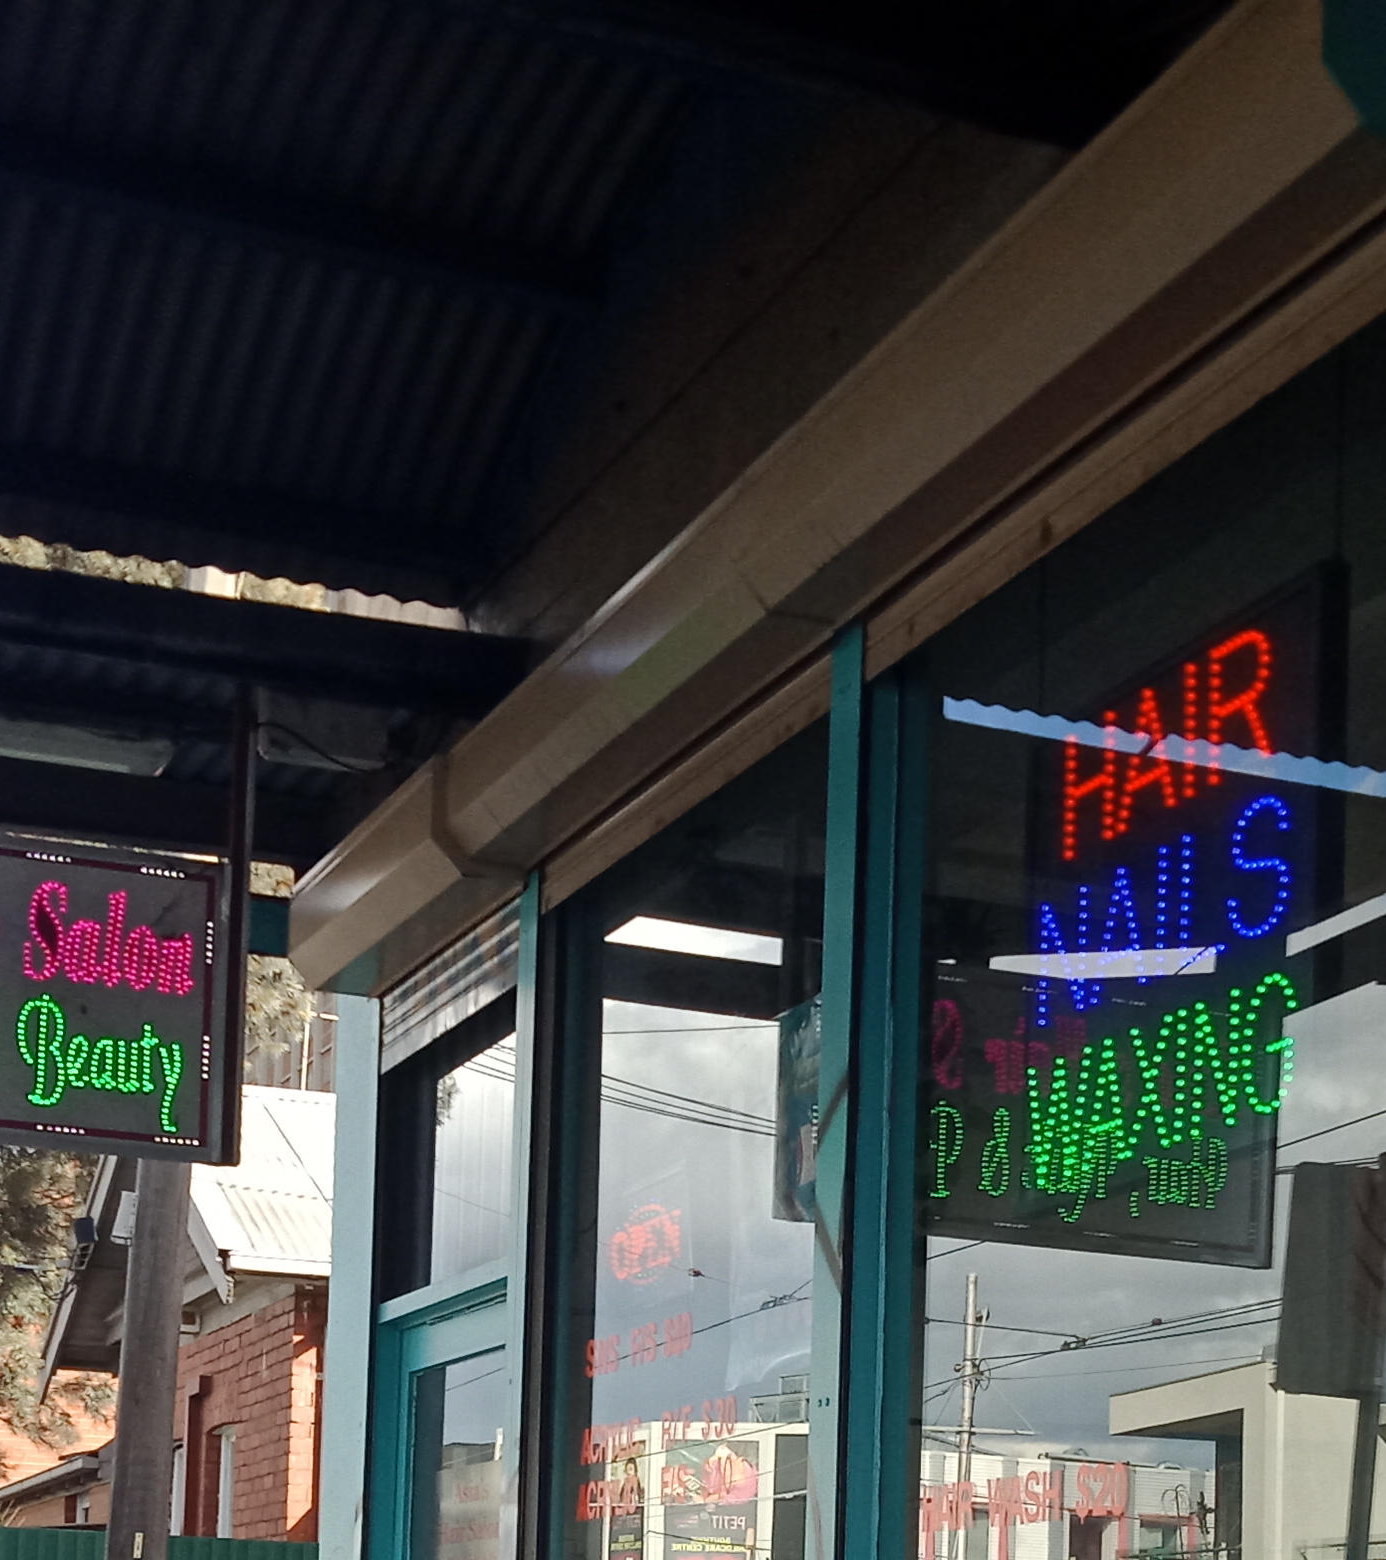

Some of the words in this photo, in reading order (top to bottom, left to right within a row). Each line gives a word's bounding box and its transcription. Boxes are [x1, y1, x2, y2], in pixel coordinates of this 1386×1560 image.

[1061, 629, 1274, 861] HAIR
[22, 878, 195, 996] Salon
[1036, 794, 1292, 1027] NAILS
[16, 993, 185, 1134] Beauty
[1026, 971, 1297, 1188] WAXING
[921, 1480, 977, 1532] HAIR
[987, 1469, 1065, 1528] WASH
[1075, 1461, 1130, 1525] $20
